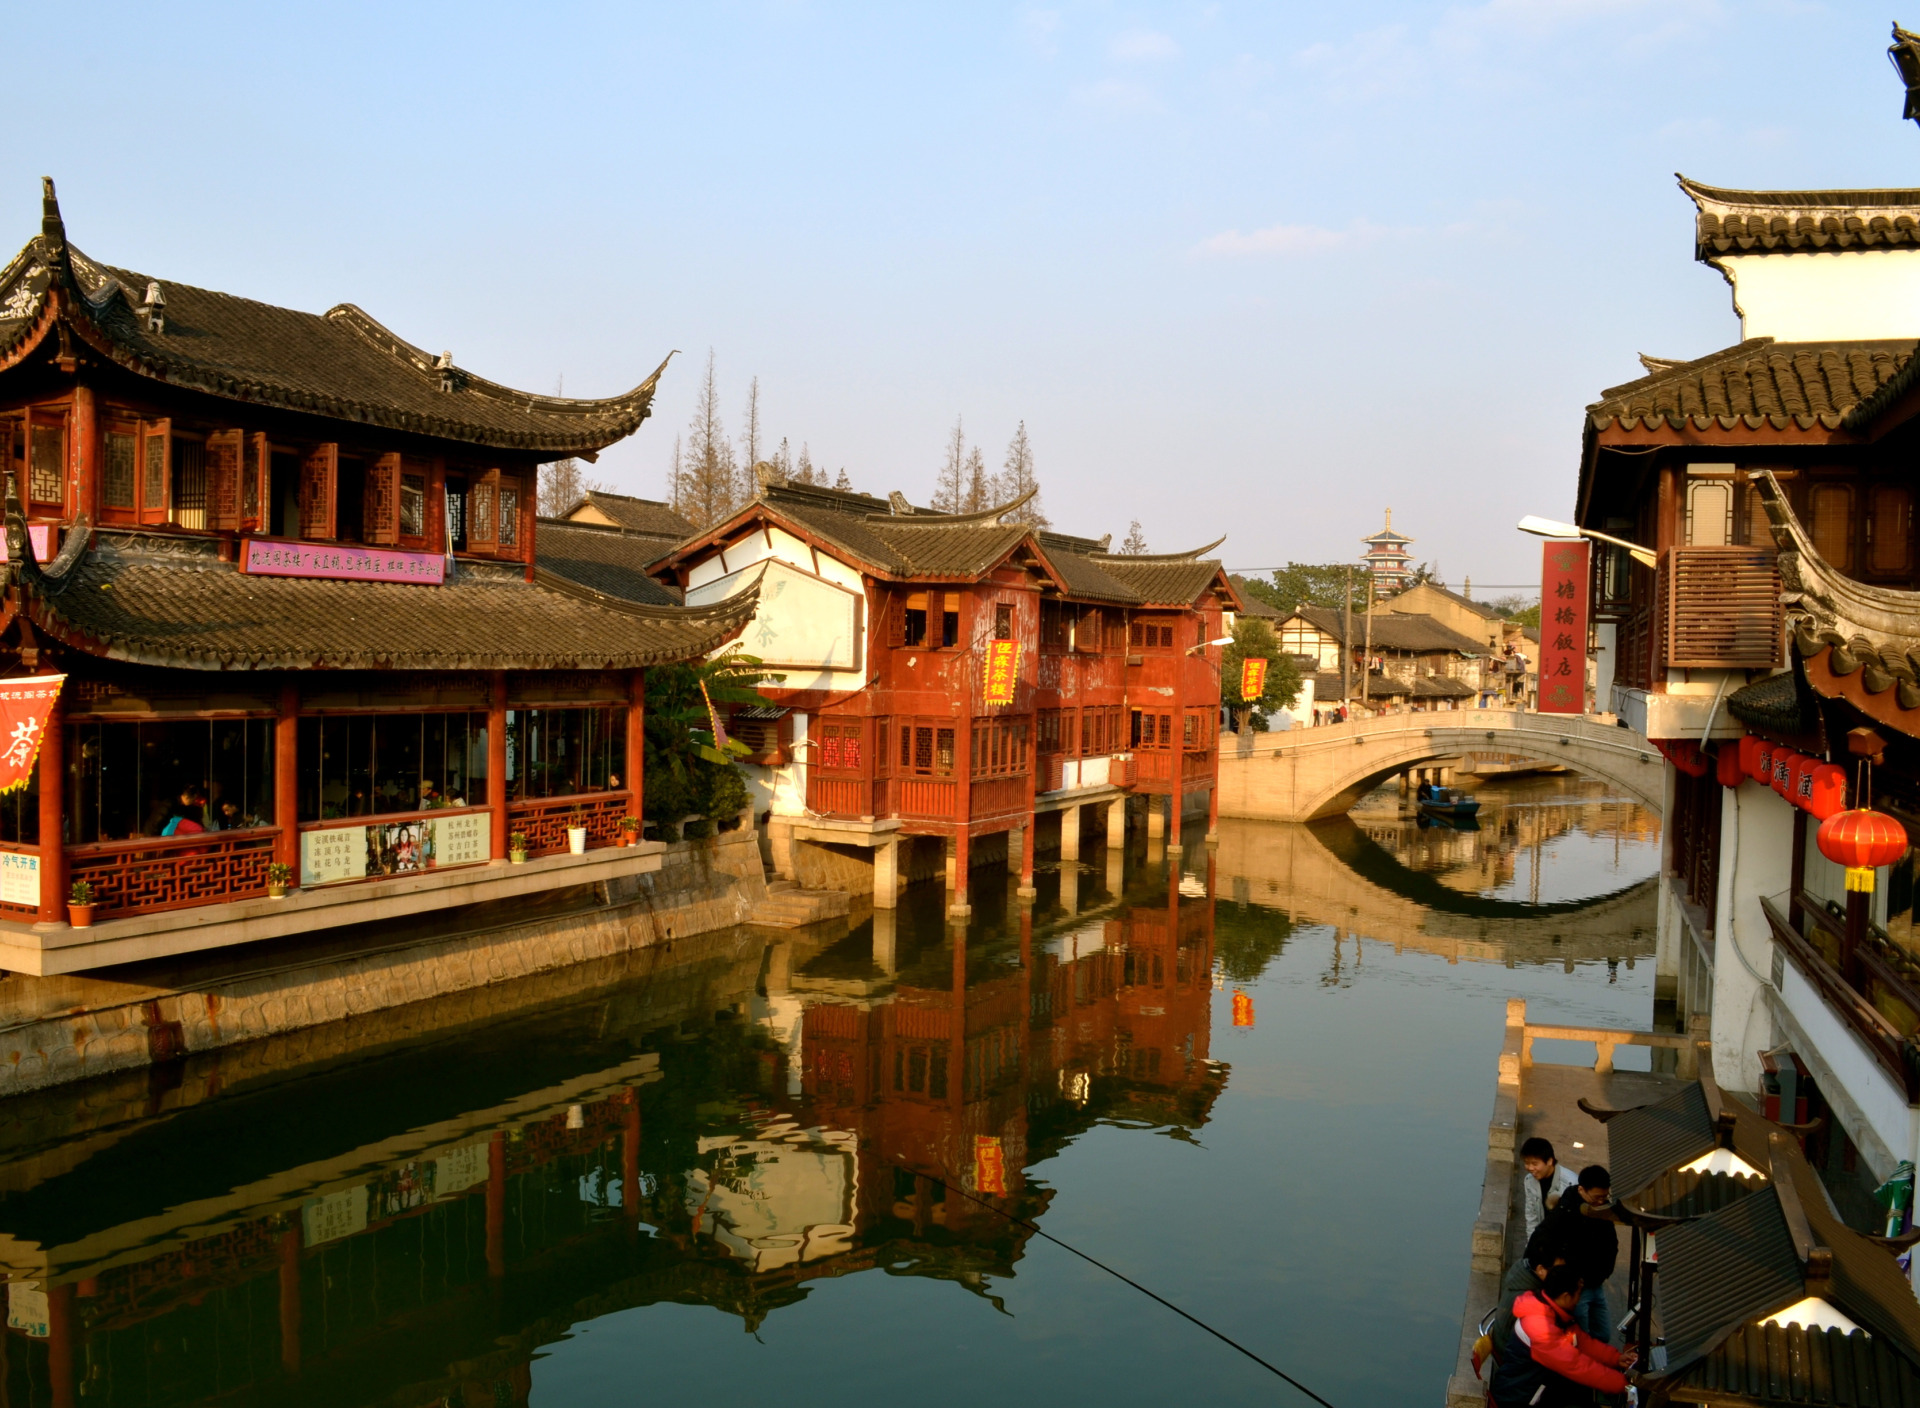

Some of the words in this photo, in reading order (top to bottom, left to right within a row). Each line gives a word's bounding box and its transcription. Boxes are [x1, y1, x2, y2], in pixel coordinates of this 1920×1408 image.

[755, 614, 778, 648] 茶
[1552, 579, 1577, 677] 塘橋飯店
[1, 717, 39, 768] 茶
